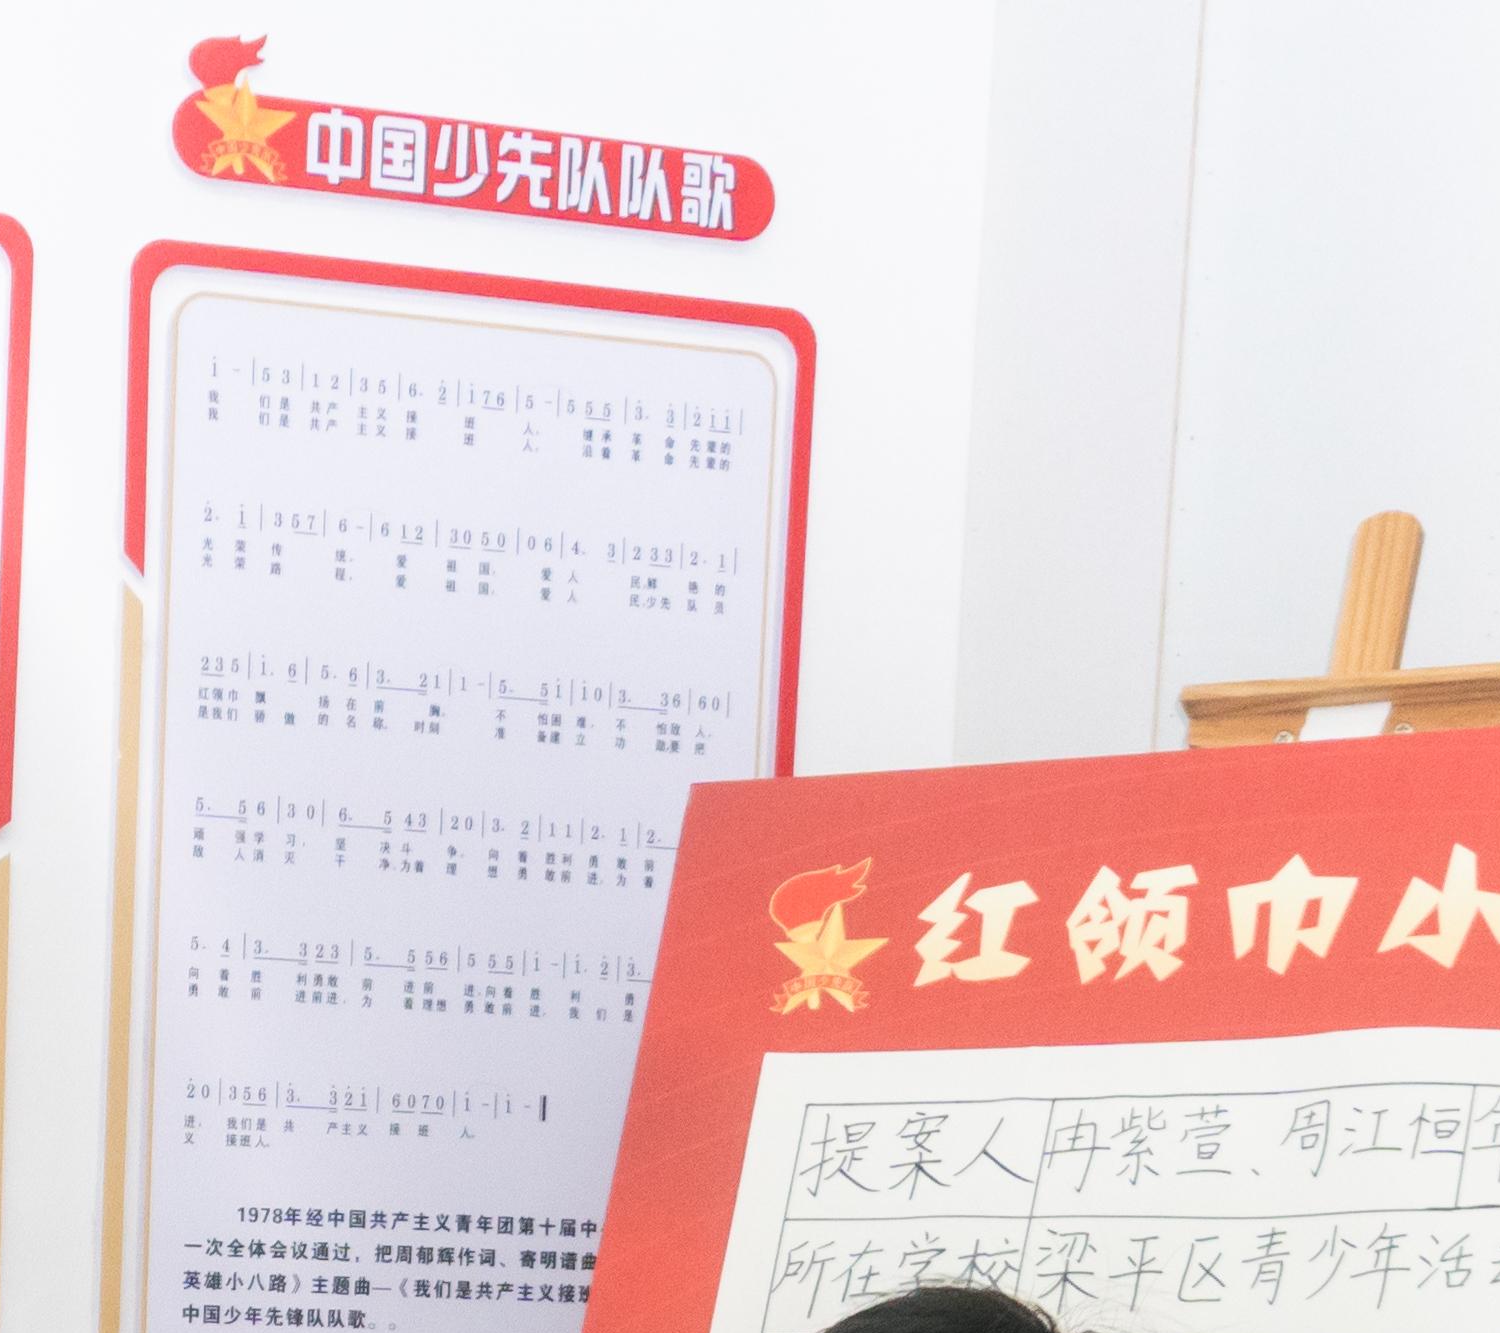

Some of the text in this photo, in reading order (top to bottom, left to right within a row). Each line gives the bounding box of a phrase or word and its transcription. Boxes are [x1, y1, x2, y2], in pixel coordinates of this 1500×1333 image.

[304, 107, 736, 232] 中国少先队队歌
[799, 1112, 1035, 1200] 提案人
[237, 1205, 603, 1239] 1978年经中国共产主义青年团第十届中
